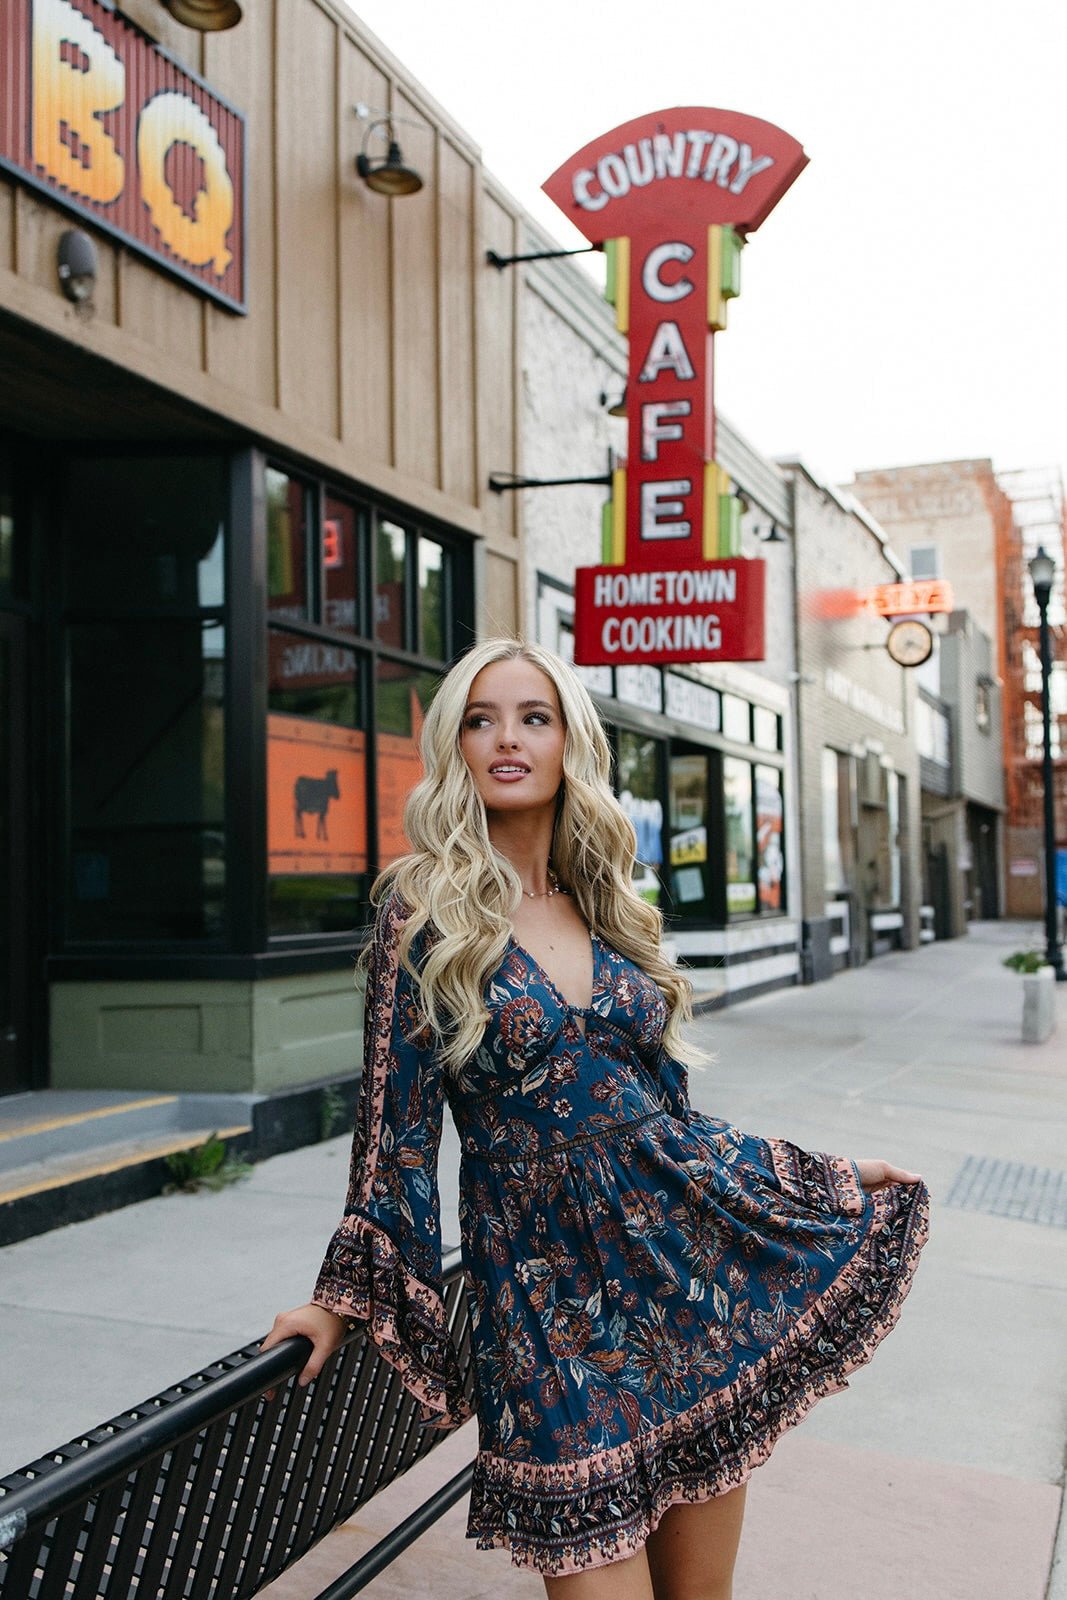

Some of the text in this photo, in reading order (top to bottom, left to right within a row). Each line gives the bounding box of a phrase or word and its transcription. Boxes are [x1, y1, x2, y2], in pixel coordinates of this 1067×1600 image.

[572, 130, 775, 212] COUNTRY
[638, 241, 697, 541] CAFE
[593, 568, 737, 607] HOMETOWN
[601, 614, 722, 652] COOKING
